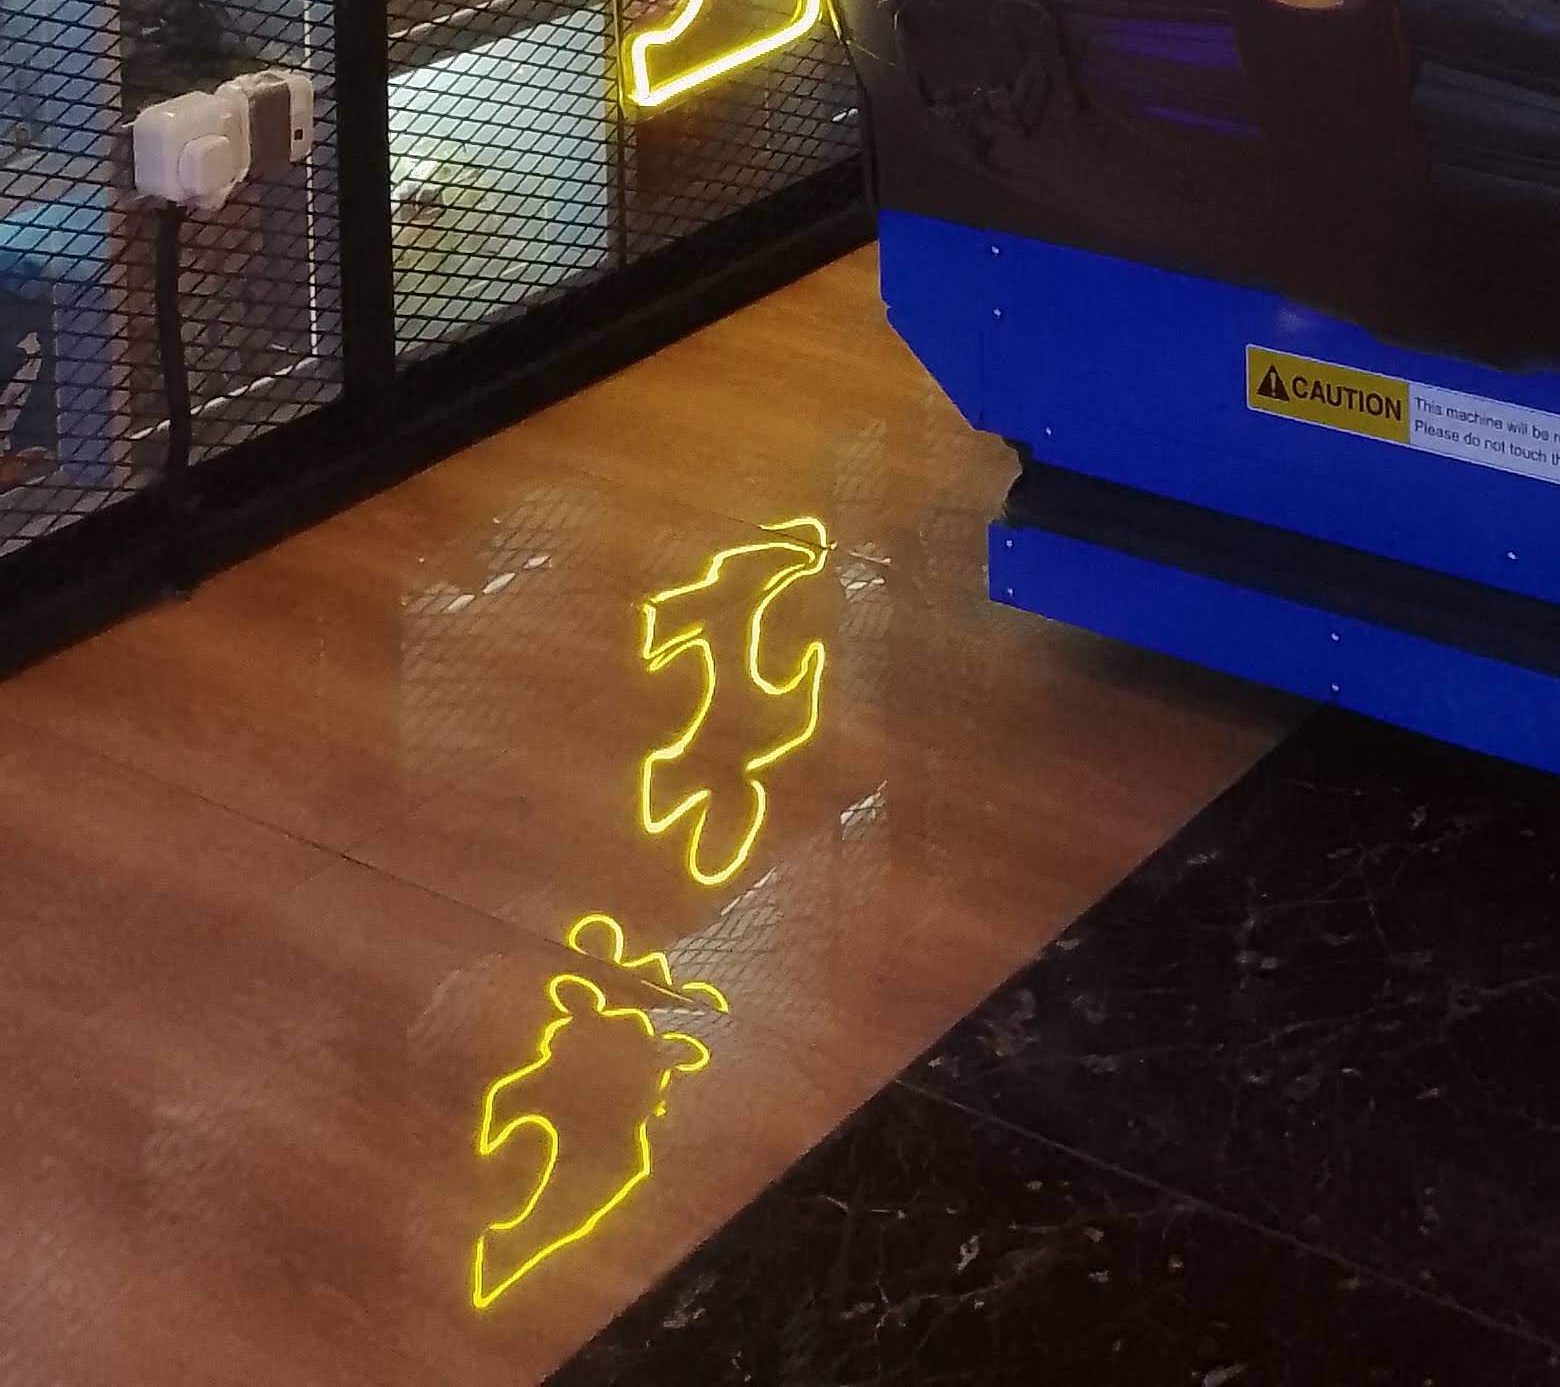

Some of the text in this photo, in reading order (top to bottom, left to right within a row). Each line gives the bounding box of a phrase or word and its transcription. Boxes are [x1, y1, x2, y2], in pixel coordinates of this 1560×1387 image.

[1291, 376, 1402, 421] CAUTION
[1415, 396, 1444, 417] This
[1446, 407, 1504, 431] machine
[1507, 421, 1529, 436] will
[1532, 425, 1549, 441] be
[1414, 418, 1460, 443] Please
[1463, 432, 1481, 447] do
[1484, 439, 1506, 454] not
[1509, 442, 1548, 464] touch
